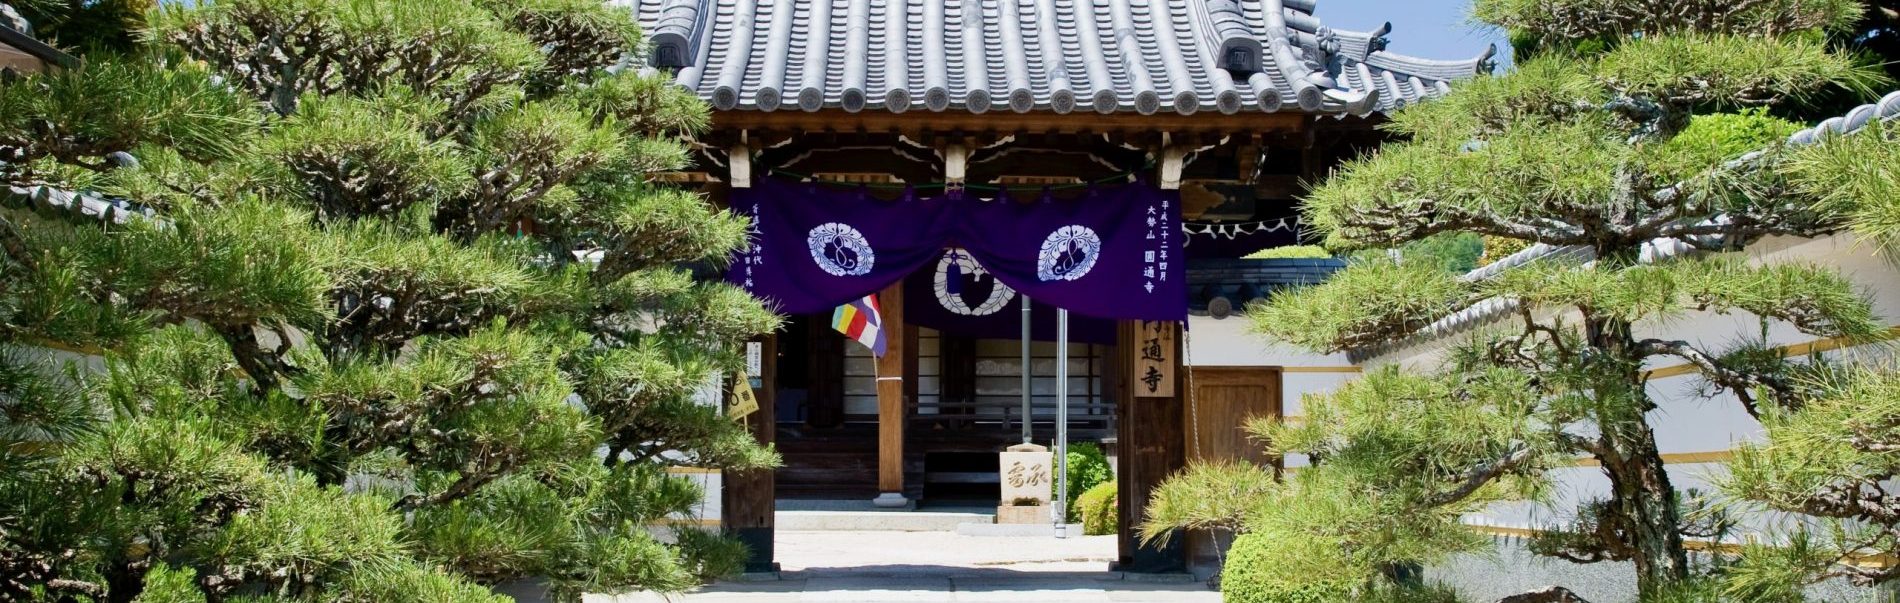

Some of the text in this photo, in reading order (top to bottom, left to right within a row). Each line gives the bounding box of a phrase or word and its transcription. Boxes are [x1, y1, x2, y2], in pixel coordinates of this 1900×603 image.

[1146, 205, 1157, 240] 大勢山
[1159, 200, 1169, 282] 平成二十二年四月
